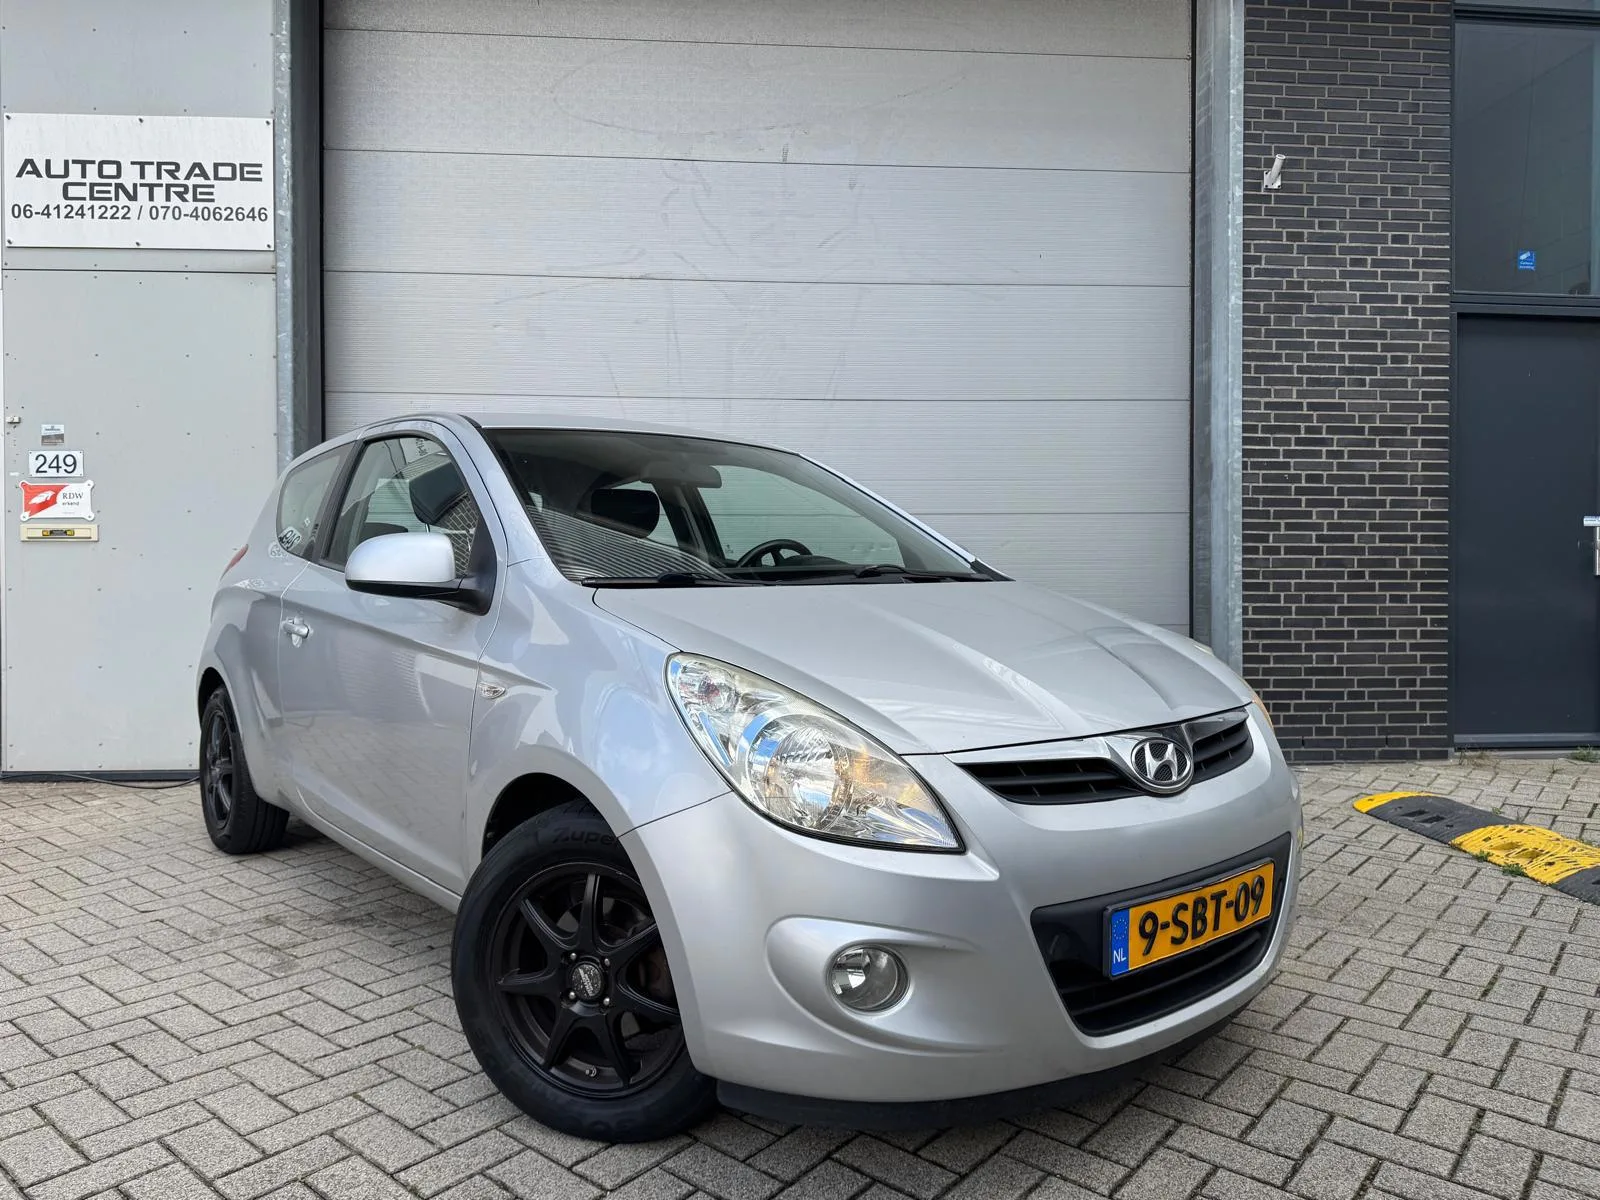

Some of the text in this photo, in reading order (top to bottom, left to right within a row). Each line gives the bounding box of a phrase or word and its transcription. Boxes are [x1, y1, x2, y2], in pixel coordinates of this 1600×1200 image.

[15, 158, 263, 182] AUTO TRADE
[62, 181, 215, 203] CENTRE
[11, 203, 131, 220] 06-41241222
[149, 206, 268, 222] 070-4062646
[35, 453, 77, 474] 249
[62, 491, 84, 500] RDW
[1138, 874, 1265, 957] 9-SBT-09
[1113, 948, 1127, 964] NL
